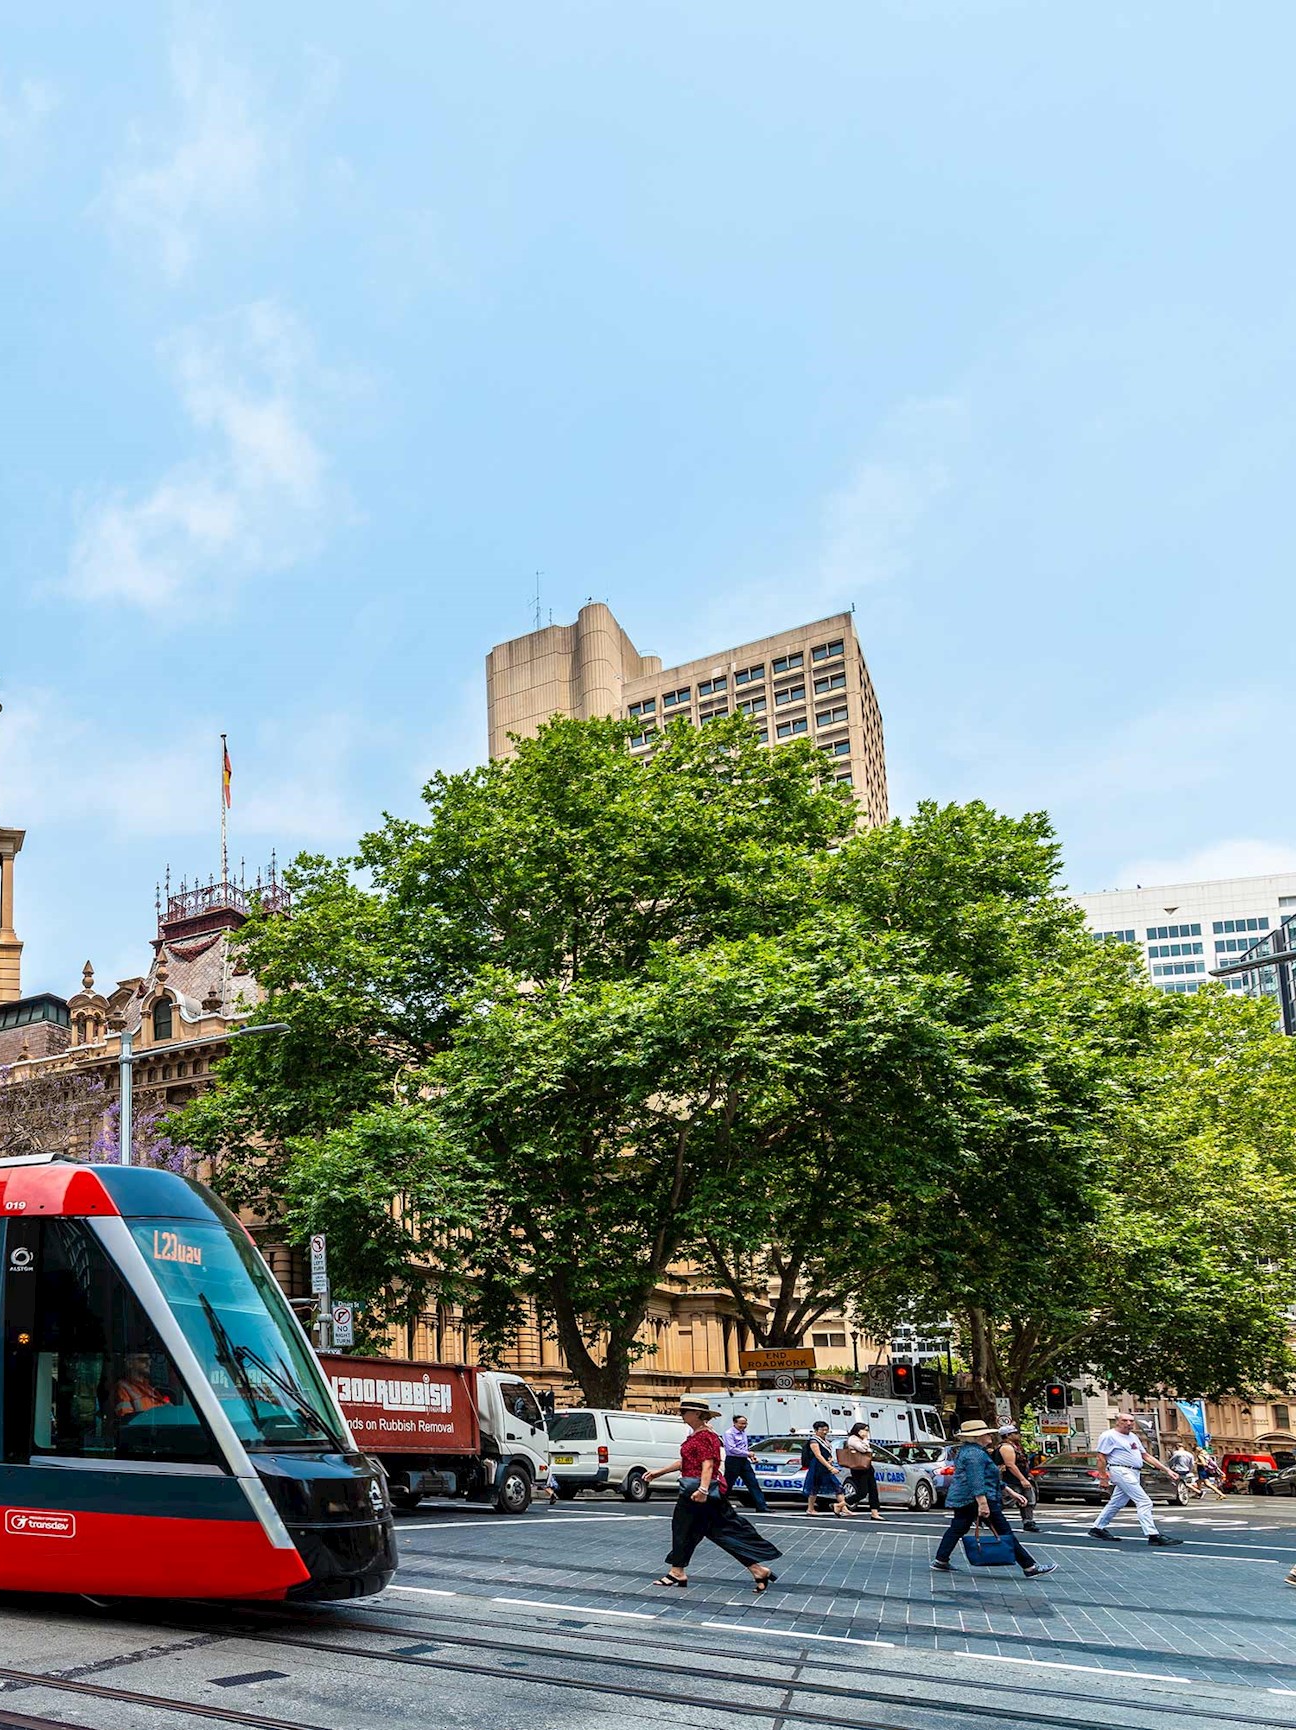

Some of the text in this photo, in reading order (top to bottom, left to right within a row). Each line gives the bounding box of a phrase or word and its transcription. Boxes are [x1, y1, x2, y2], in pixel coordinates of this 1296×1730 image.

[5, 1201, 26, 1210] 019
[766, 1352, 787, 1360] END
[748, 1359, 807, 1368] ROADWORK
[778, 1378, 790, 1387] 30
[346, 1418, 454, 1433] nds on Rubbish Removal
[886, 1472, 905, 1483] CABS
[764, 1479, 803, 1489] CABS
[28, 1520, 69, 1531] transdev
